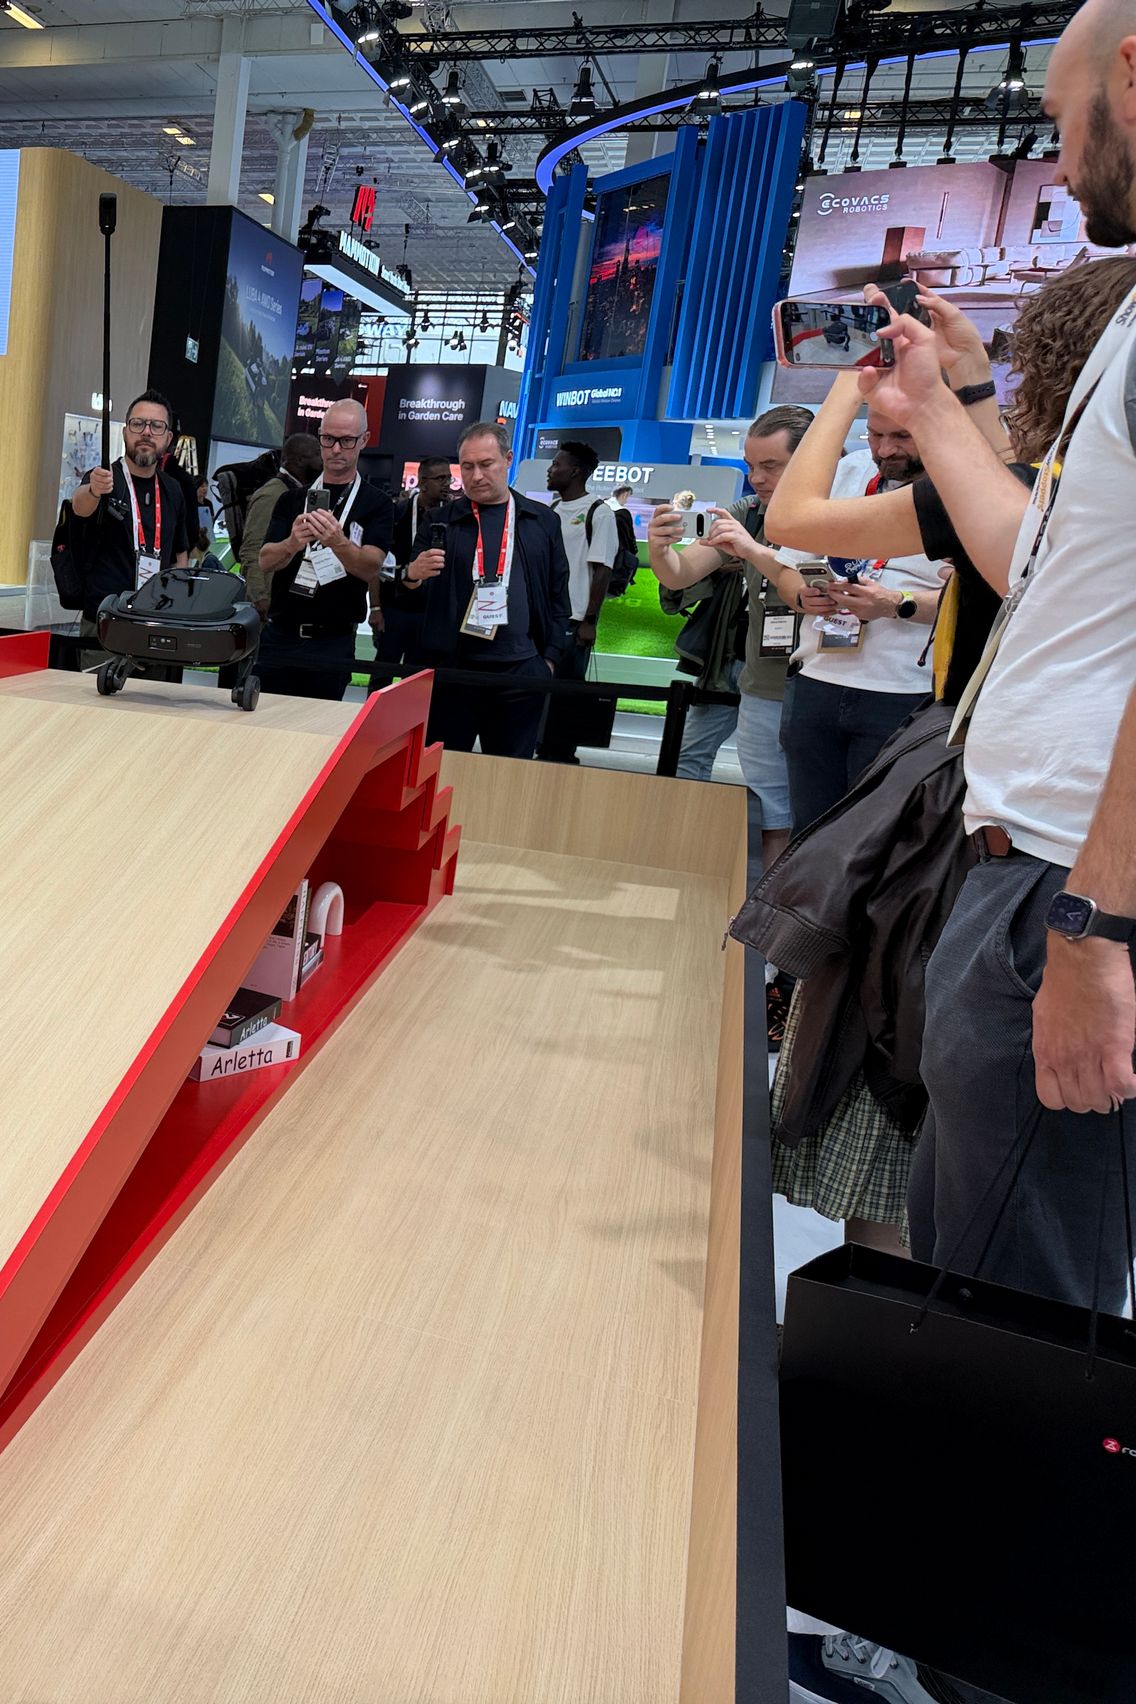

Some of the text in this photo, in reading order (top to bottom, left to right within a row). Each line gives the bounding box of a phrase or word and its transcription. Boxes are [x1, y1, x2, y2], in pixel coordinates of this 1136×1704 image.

[821, 194, 890, 210] ECOVACS
[842, 204, 888, 214] ROBOTICS
[399, 399, 465, 411] Breakthrough
[556, 389, 591, 407] WINBOT
[398, 411, 464, 421] in Garden Care
[240, 1015, 268, 1041] Arletta
[211, 1048, 273, 1076] Arletta
